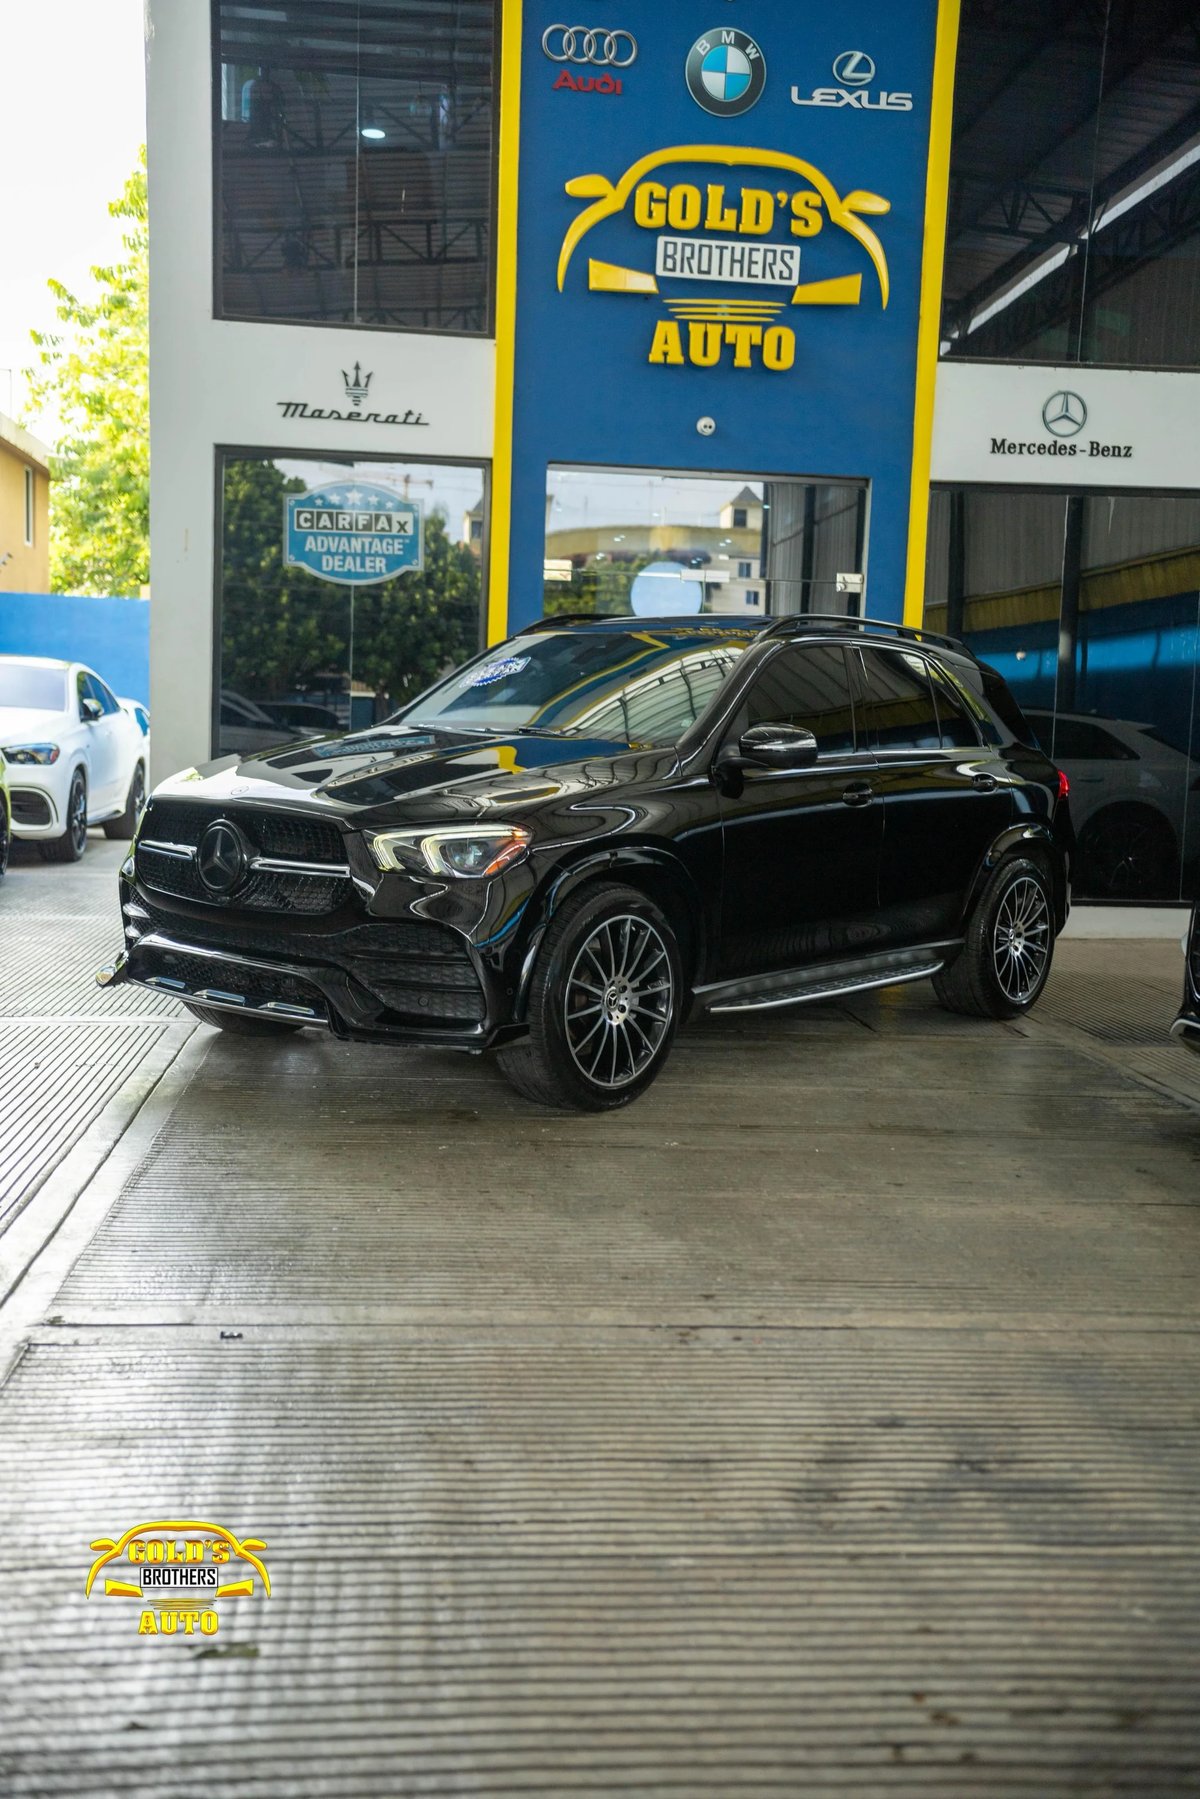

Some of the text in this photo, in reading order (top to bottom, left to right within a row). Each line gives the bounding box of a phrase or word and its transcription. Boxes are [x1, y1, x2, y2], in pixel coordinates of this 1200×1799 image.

[696, 31, 760, 59] BMW
[553, 70, 622, 95] Audi
[791, 86, 913, 111] LEXUS
[634, 182, 823, 237] GOLD'S
[662, 241, 795, 281] BROTHERS
[648, 320, 796, 371] AUTO
[276, 402, 430, 426] Maserati
[990, 438, 1133, 458] Mercedes-Benz
[298, 511, 409, 534] CARFAX
[304, 535, 404, 555] ADVANTAGE
[321, 555, 387, 573] DEALER
